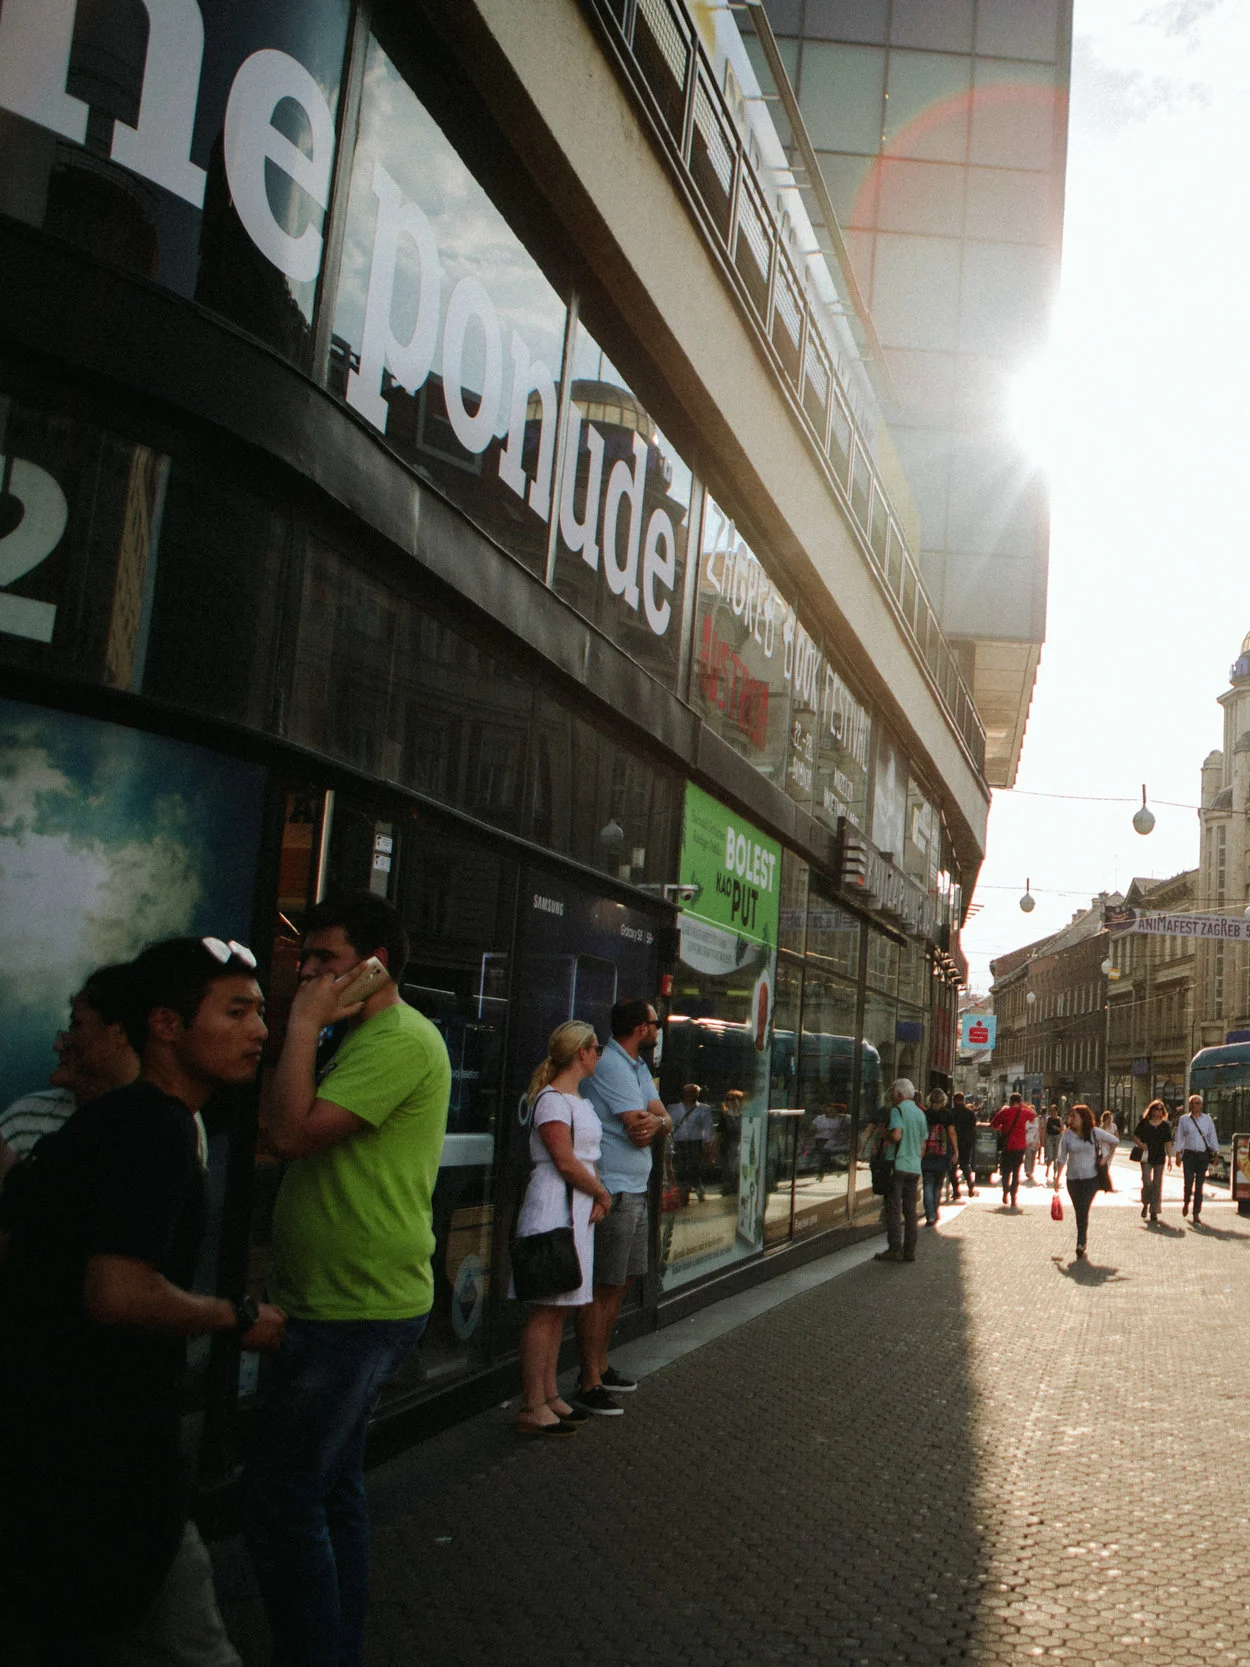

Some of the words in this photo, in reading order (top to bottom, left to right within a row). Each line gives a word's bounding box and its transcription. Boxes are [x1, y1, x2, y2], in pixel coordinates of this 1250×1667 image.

[346, 158, 676, 636] ponude
[707, 502, 775, 659] ZAGREB
[783, 605, 822, 712] BOOK
[725, 826, 776, 892] BOLEST
[533, 894, 564, 917] SAMSUNG
[716, 872, 731, 898] KAO
[731, 878, 759, 930] PUT
[1138, 913, 1200, 934] ANIMAFEST
[1201, 918, 1240, 937] ZAGREB
